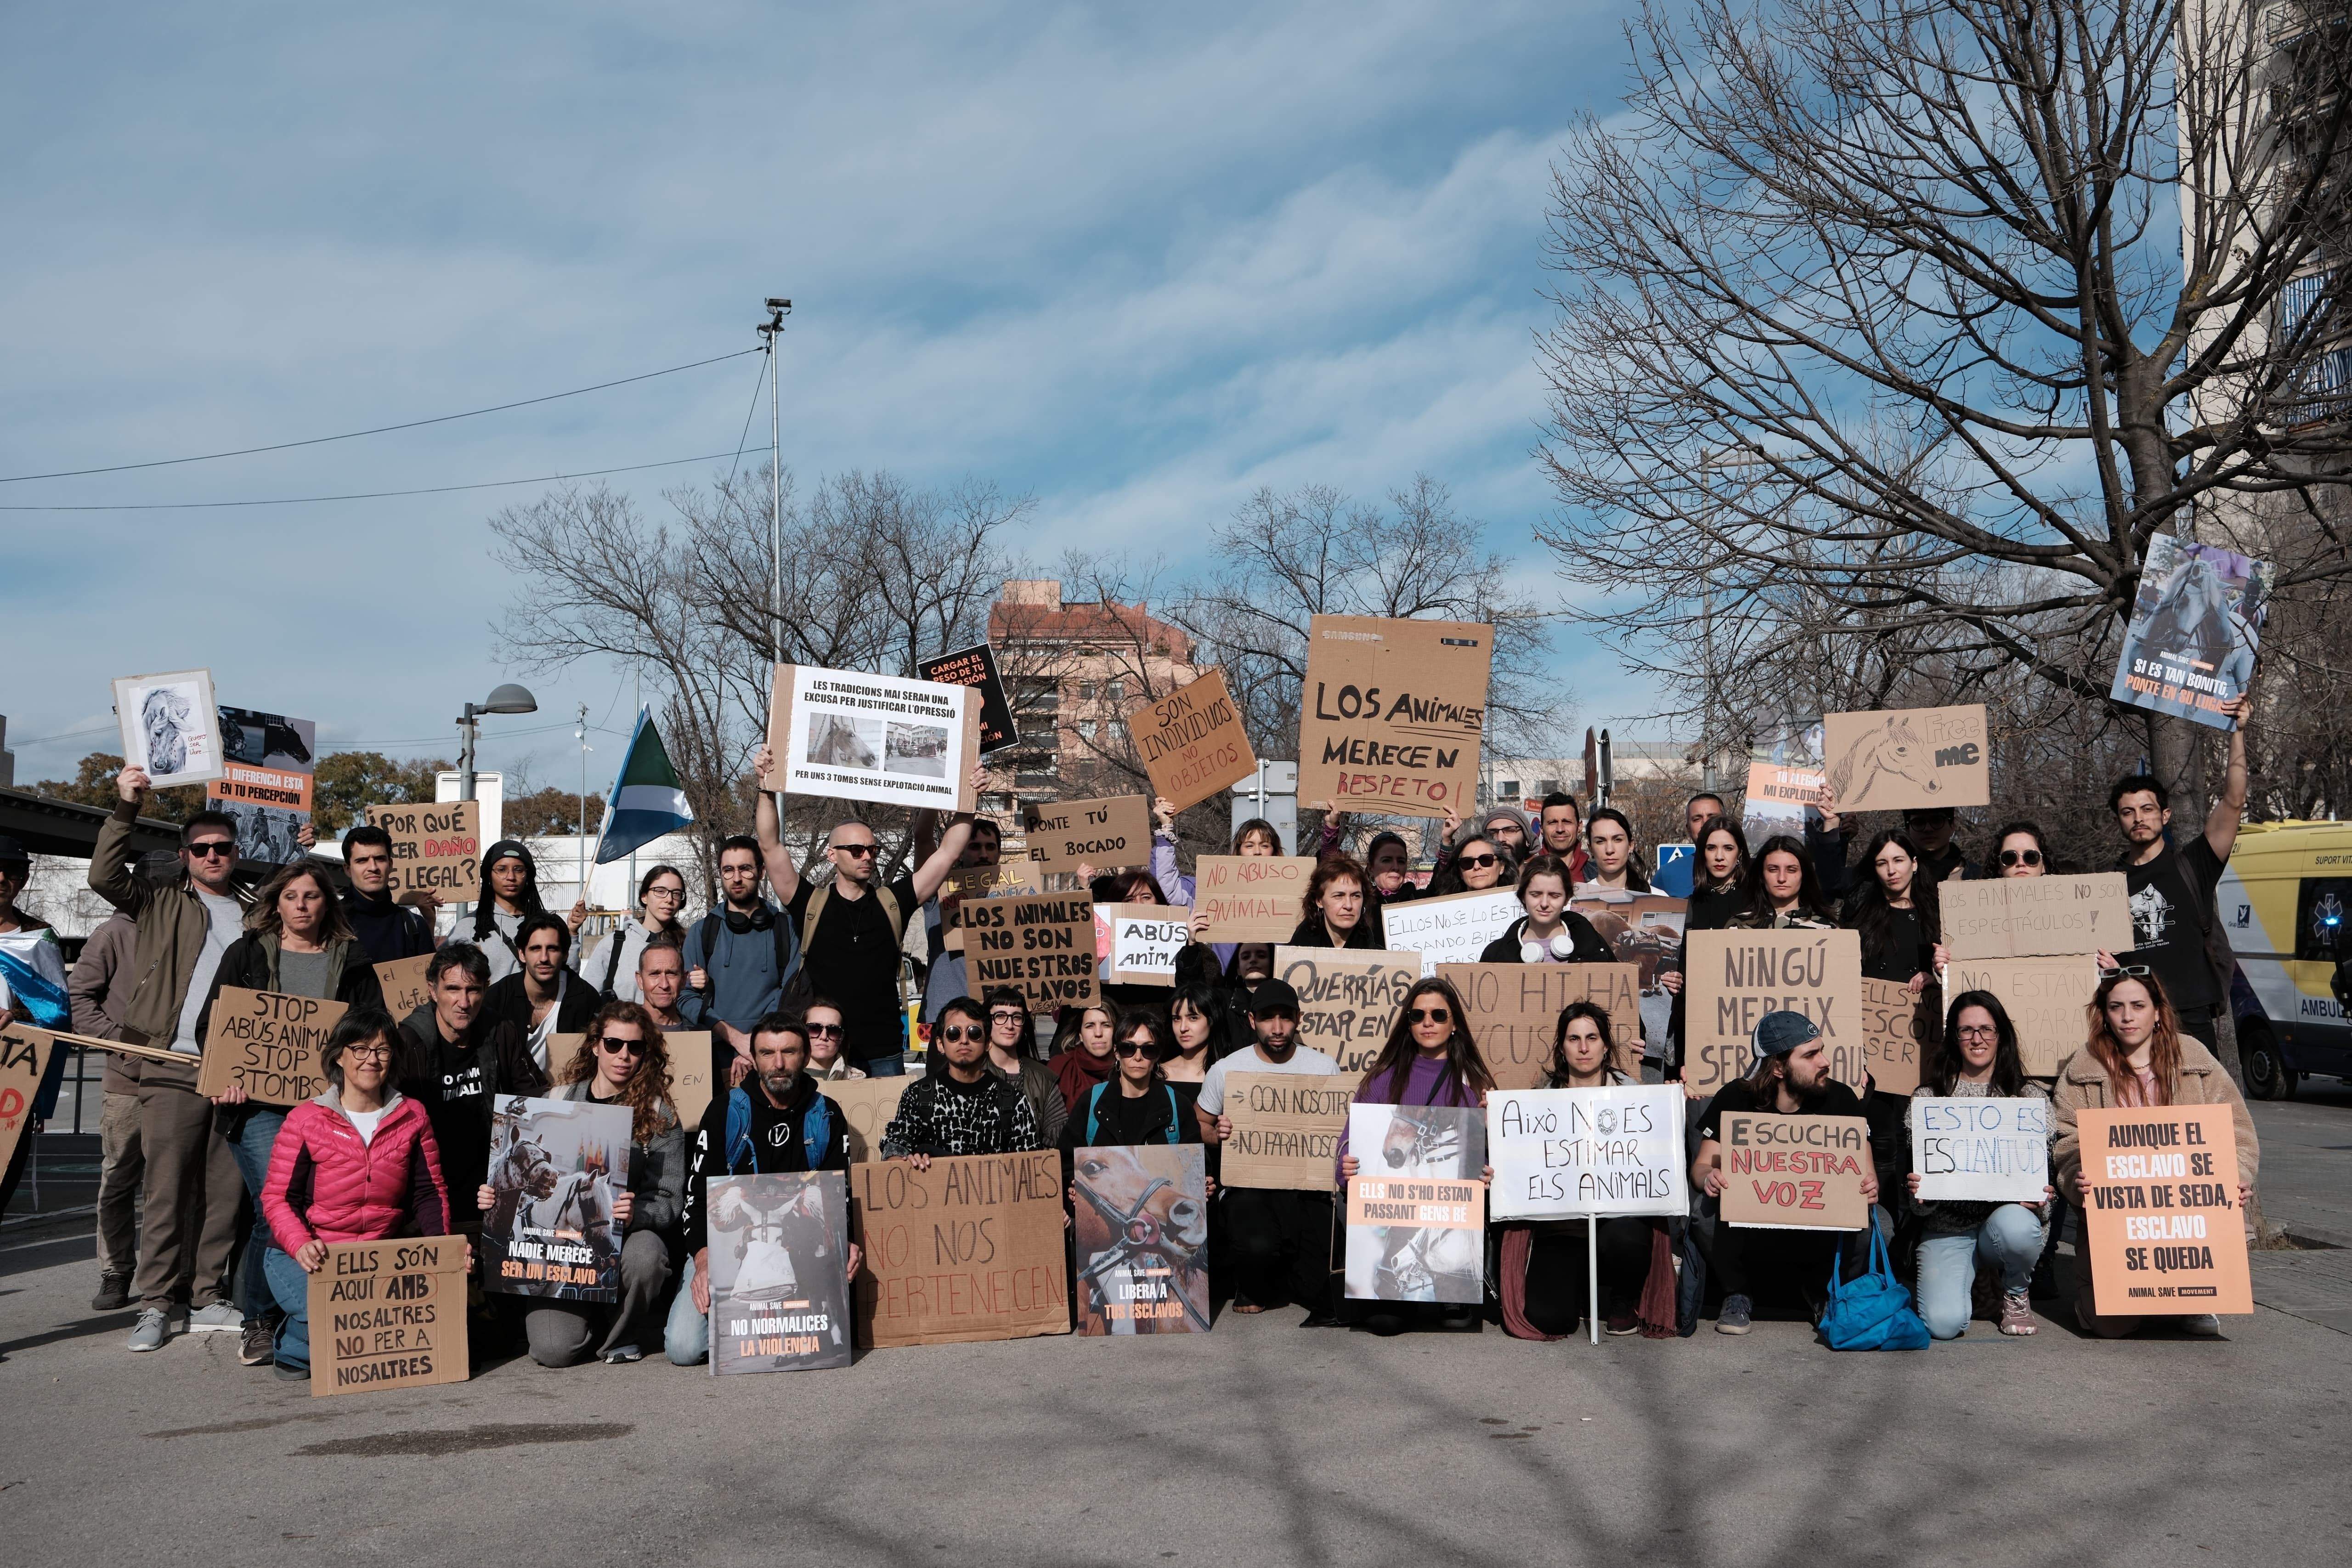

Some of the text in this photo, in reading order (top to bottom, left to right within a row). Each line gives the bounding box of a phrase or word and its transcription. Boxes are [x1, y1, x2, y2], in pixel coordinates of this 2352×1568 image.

[931, 654, 982, 675] CARGAR EL
[2160, 651, 2177, 661] ANIMAL
[959, 668, 971, 677] DE
[972, 663, 984, 672] TU
[2134, 658, 2228, 699] SI ES TAN BONITO,
[813, 680, 949, 705] LES TRADICIONS MAI SERAN UNA
[1316, 682, 1380, 721] LOS
[2125, 674, 2195, 705] PONTE EN SU
[804, 692, 956, 718] EXCUSA PER JUSTIFICAR L'OPRESSIÓ
[1155, 692, 1193, 727] SON
[1142, 697, 1232, 762] INDIVIDUOS
[1925, 714, 1981, 744] Free
[1171, 742, 1238, 791] OBJETOS
[1182, 745, 1198, 762] NO
[1934, 742, 1980, 768] me
[232, 769, 303, 790] DIFERENCIA ESTÁ
[795, 770, 808, 779] PER
[810, 772, 825, 780] UNS
[833, 774, 858, 784] TOMBS
[860, 777, 882, 786] SENSE
[883, 779, 924, 791] EXPLOTACIÓ
[926, 785, 952, 795] ANIMAL
[220, 782, 300, 805] EN TU PERCEPCIÓN
[424, 804, 466, 832] QUÉ
[1027, 805, 1108, 834] PONTE TÚ
[424, 836, 476, 857] DAÑO
[1031, 836, 1126, 862] EL BOCADO
[405, 858, 476, 890] LEGAL?
[2315, 856, 2341, 865] SUPORT
[947, 870, 1025, 893] LEGAL
[1207, 863, 1299, 888] NO ABUSO
[1943, 894, 1967, 908] LOS
[2075, 884, 2092, 899] NO
[2098, 883, 2125, 899] SON
[963, 901, 1091, 928] LOS ANIMALES
[980, 928, 1073, 951] NO SON
[1123, 922, 1188, 943] ABÚS
[977, 953, 1092, 980] NUESTROS
[1283, 959, 1413, 1010] QUERRÍAS
[1445, 971, 1571, 1013] NO HI
[254, 992, 319, 1022] STOP
[220, 1015, 277, 1043] ABÚS
[243, 1043, 310, 1071] STOP
[1866, 1037, 1915, 1064] SER
[683, 1073, 704, 1085] EN
[1250, 1085, 1286, 1112] CON
[1503, 1100, 1556, 1137] Això
[1624, 1103, 1652, 1133] ÉS
[1925, 1105, 2046, 1133] ESTO ES
[332, 1130, 352, 1140] MAMMUT
[1239, 1131, 1298, 1157] NO PARA
[1731, 1119, 1860, 1150] ESCUCHA
[2109, 1122, 2206, 1150] AUNQUE EL
[1731, 1149, 1861, 1175] NUESTRA
[1924, 1137, 2046, 1174] ESCLAVITUD
[2105, 1152, 2214, 1179] ESCLAVO SE
[865, 1155, 1059, 1211] LOS ANIMALES
[1360, 1183, 1472, 1202] ELLS NO S'HO ESTAN
[1529, 1173, 1564, 1200] ELS
[1752, 1180, 1826, 1210] VOZ
[2093, 1183, 2233, 1210] VISTA DE SEDA,
[1364, 1203, 1466, 1222] PASSANT GENS BÉ
[522, 1227, 541, 1236] ANIMAL
[543, 1229, 555, 1237] SAVE
[2126, 1215, 2206, 1240] ESCLAVO
[509, 1241, 593, 1264] NADIE MERECE
[864, 1217, 995, 1270] NO NOS
[336, 1245, 439, 1276] ELLS SÓN
[501, 1261, 596, 1285] SER UN ESCLAVO
[1115, 1269, 1132, 1278] ANIMAL
[2125, 1246, 2214, 1274] SE QUEDA
[330, 1274, 430, 1302] AQUÍ AMB
[865, 1265, 1065, 1320] PERTENECEN
[1119, 1283, 1167, 1300] LIBERA A
[2128, 1287, 2157, 1297] ANIMAL
[2158, 1286, 2176, 1297] SAVE
[334, 1304, 436, 1332] NOSALTRES
[1104, 1302, 1183, 1319] TUS ESCLAVOS
[731, 1314, 828, 1336] NO NORMALICES
[336, 1328, 430, 1357] NO PER A
[741, 1336, 820, 1357] LA VIOLENCIA
[337, 1355, 433, 1387] NOSALTRES
